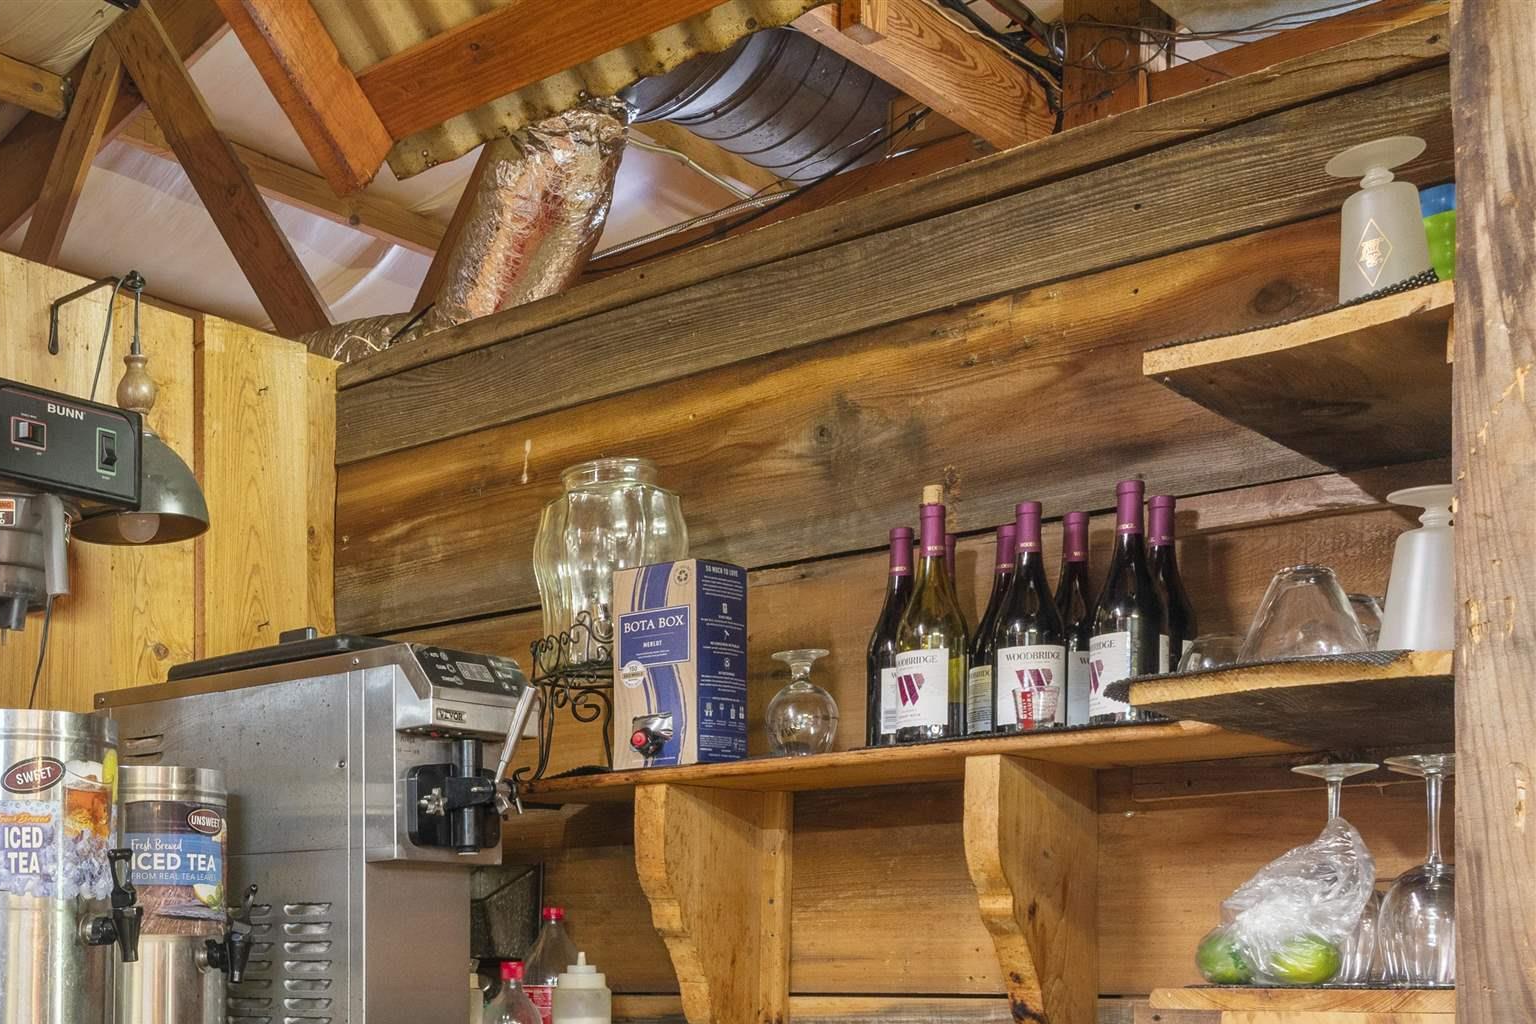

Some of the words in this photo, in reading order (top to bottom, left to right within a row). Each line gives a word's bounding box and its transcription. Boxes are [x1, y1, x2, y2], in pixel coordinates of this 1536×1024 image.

[48, 403, 84, 420] BUNN
[624, 619, 655, 634] BOTA
[659, 615, 684, 628] BOX
[1006, 650, 1062, 662] WOODBRIDGE
[15, 766, 53, 785] SWEET
[191, 815, 220, 828] UNSWEET
[4, 826, 44, 849] ICED
[131, 837, 151, 851] Fresh
[7, 852, 41, 874] TEA
[131, 852, 181, 871] ICED
[186, 853, 217, 871] TEA
[131, 873, 156, 881] FROM
[160, 873, 179, 881] REAL
[182, 873, 196, 881] TEA
